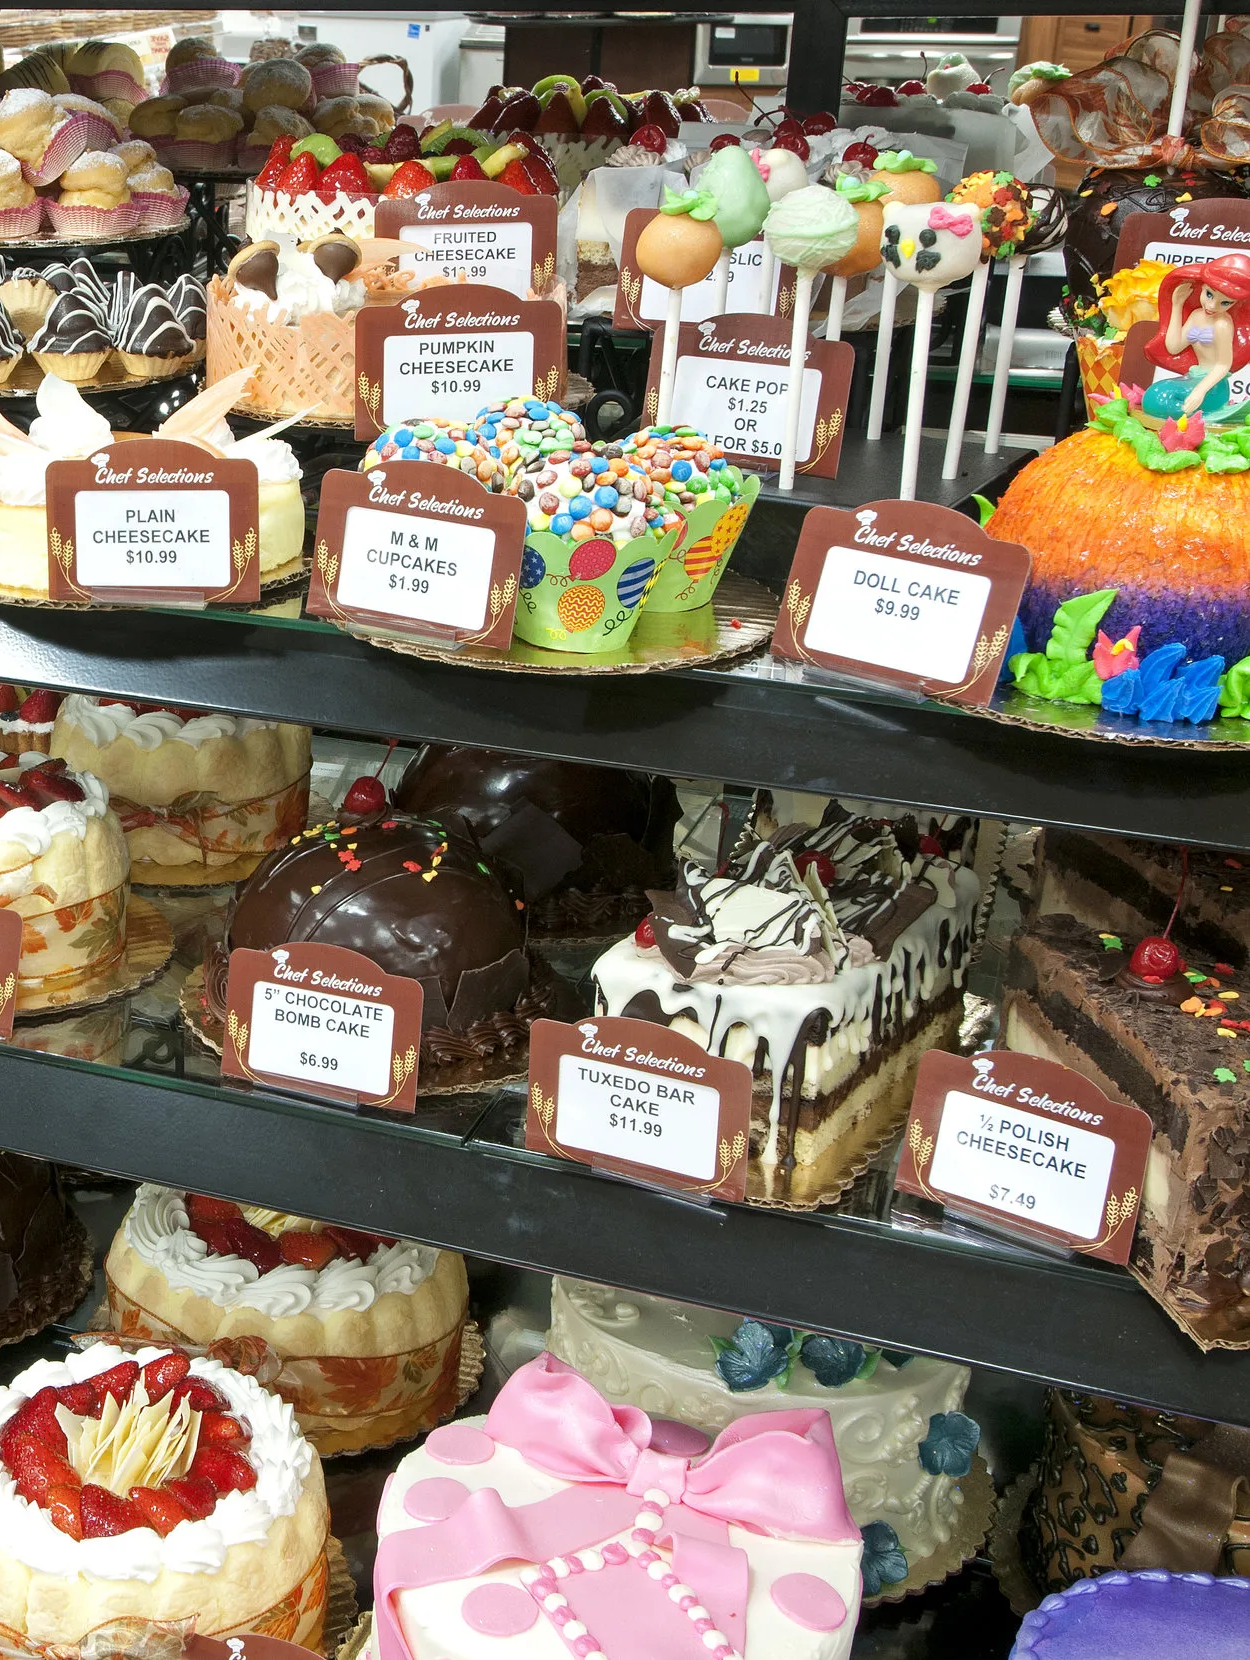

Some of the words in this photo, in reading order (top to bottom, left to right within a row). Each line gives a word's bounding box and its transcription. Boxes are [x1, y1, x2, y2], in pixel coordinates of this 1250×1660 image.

[418, 204, 450, 220] Chef
[453, 203, 520, 219] Selections
[434, 231, 497, 244] FRUITED
[1170, 221, 1210, 239] Chef
[1210, 224, 1250, 243] Selec
[414, 247, 516, 262] CHEESECAKE
[729, 252, 763, 266] SLIC
[404, 311, 441, 329] Chef
[444, 311, 521, 328] Selections
[419, 340, 494, 355] PUMPKIN
[698, 335, 736, 353] Chef
[736, 339, 812, 361] Selectios
[399, 359, 514, 375] CHEESECAKE
[431, 379, 481, 394] $10.99
[706, 375, 751, 392] CAKE
[727, 396, 768, 414] $1.25
[734, 418, 758, 433] OR
[713, 435, 747, 451] FOR
[751, 439, 782, 456] $5.0
[94, 466, 134, 484] Chef
[136, 467, 215, 484] Selections
[368, 484, 406, 507] Chef
[407, 491, 485, 520] Selections
[125, 509, 176, 523] PLAIN
[92, 529, 211, 544] CHEESECAKE
[390, 530, 404, 546] M
[408, 533, 420, 549] &
[424, 536, 439, 552] M
[853, 525, 899, 549] Chef
[896, 534, 983, 567] Selections
[126, 549, 177, 565] $10.99
[366, 548, 458, 577] CUPCAKES
[388, 573, 430, 595] $1.99
[853, 570, 901, 594] DOLL
[907, 581, 961, 606] CAKE
[874, 597, 921, 621] $9.99
[273, 963, 310, 983] Chef
[310, 970, 383, 998] Selections
[284, 991, 384, 1022] CHOCOLATE
[274, 1008, 322, 1030] BOMB
[325, 1018, 371, 1039] CAKE
[299, 1051, 339, 1072] $6.99
[581, 1037, 622, 1059] Chef
[623, 1046, 707, 1079] Selections
[577, 1066, 651, 1095] TUXEDO
[656, 1083, 696, 1106] BAR
[609, 1093, 661, 1117] CAKE
[971, 1073, 1015, 1099] Chef
[1015, 1086, 1104, 1127] Selections
[608, 1112, 663, 1138] $11.99
[998, 1118, 1071, 1152] POLISH
[956, 1130, 1088, 1180] CHEESECAKE
[988, 1183, 1037, 1211] $7.49
